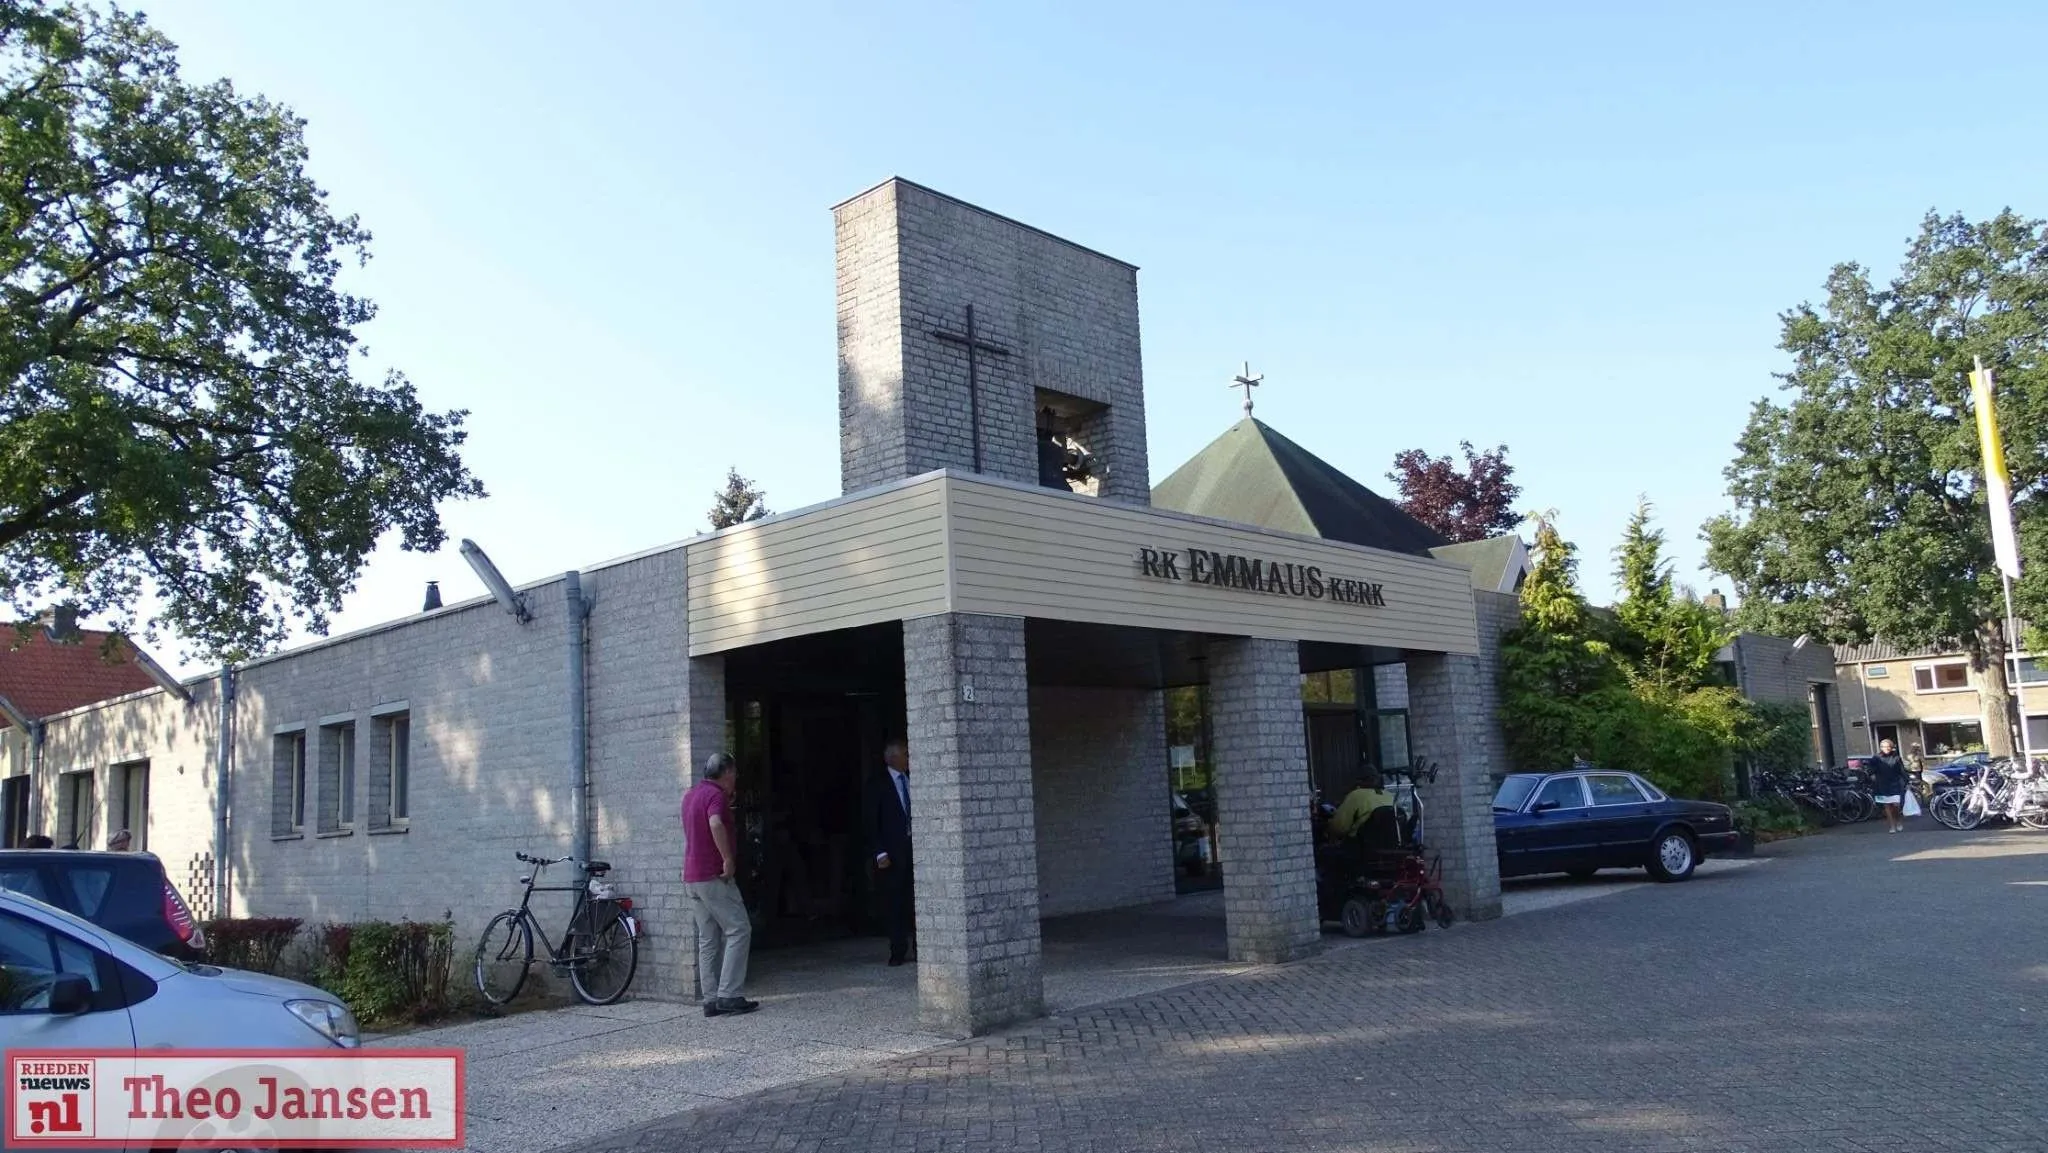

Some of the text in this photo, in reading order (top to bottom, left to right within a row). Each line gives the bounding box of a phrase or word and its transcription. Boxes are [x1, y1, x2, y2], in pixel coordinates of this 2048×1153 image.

[1140, 548, 1386, 607] RK EMMAUS KERK
